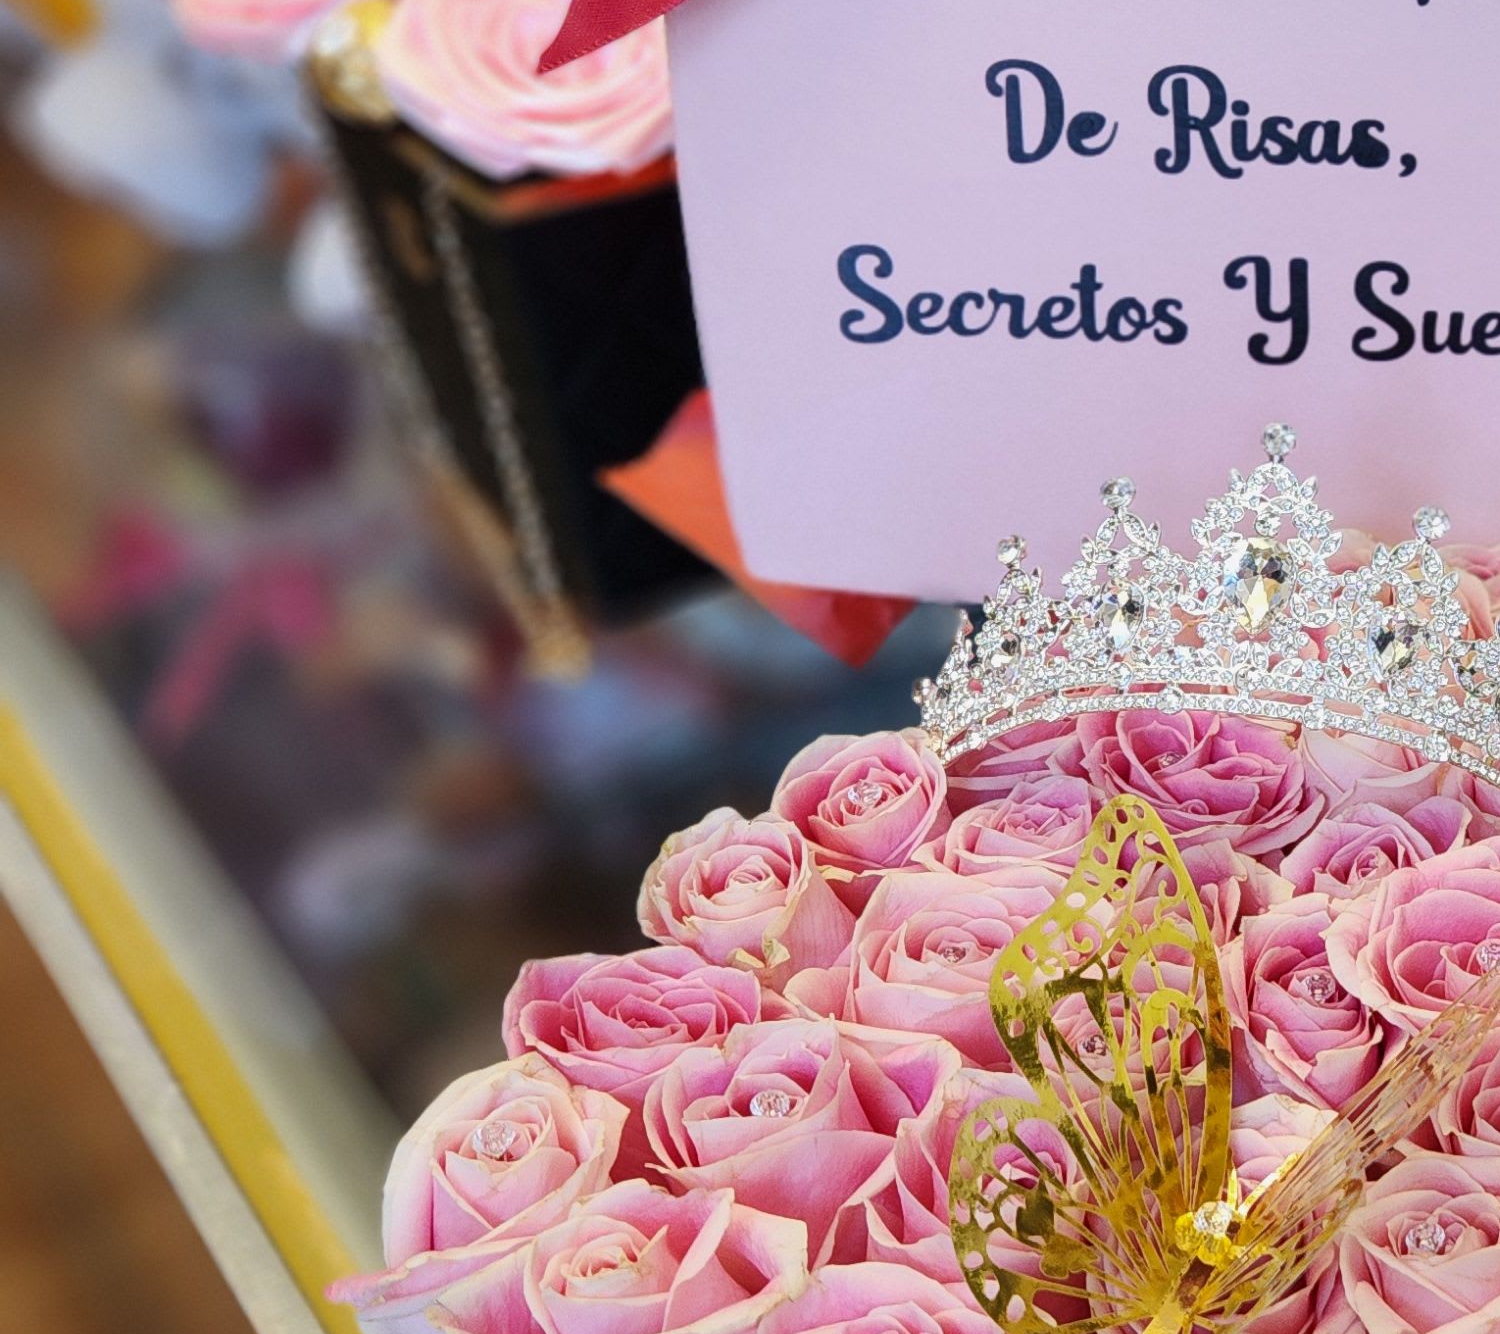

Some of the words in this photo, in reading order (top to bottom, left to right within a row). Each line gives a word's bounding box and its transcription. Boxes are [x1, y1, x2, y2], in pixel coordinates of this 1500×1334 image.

[986, 59, 1119, 164] De
[1148, 64, 1418, 179] Risas,
[838, 244, 1189, 345] Secretos
[1224, 255, 1310, 365] Y
